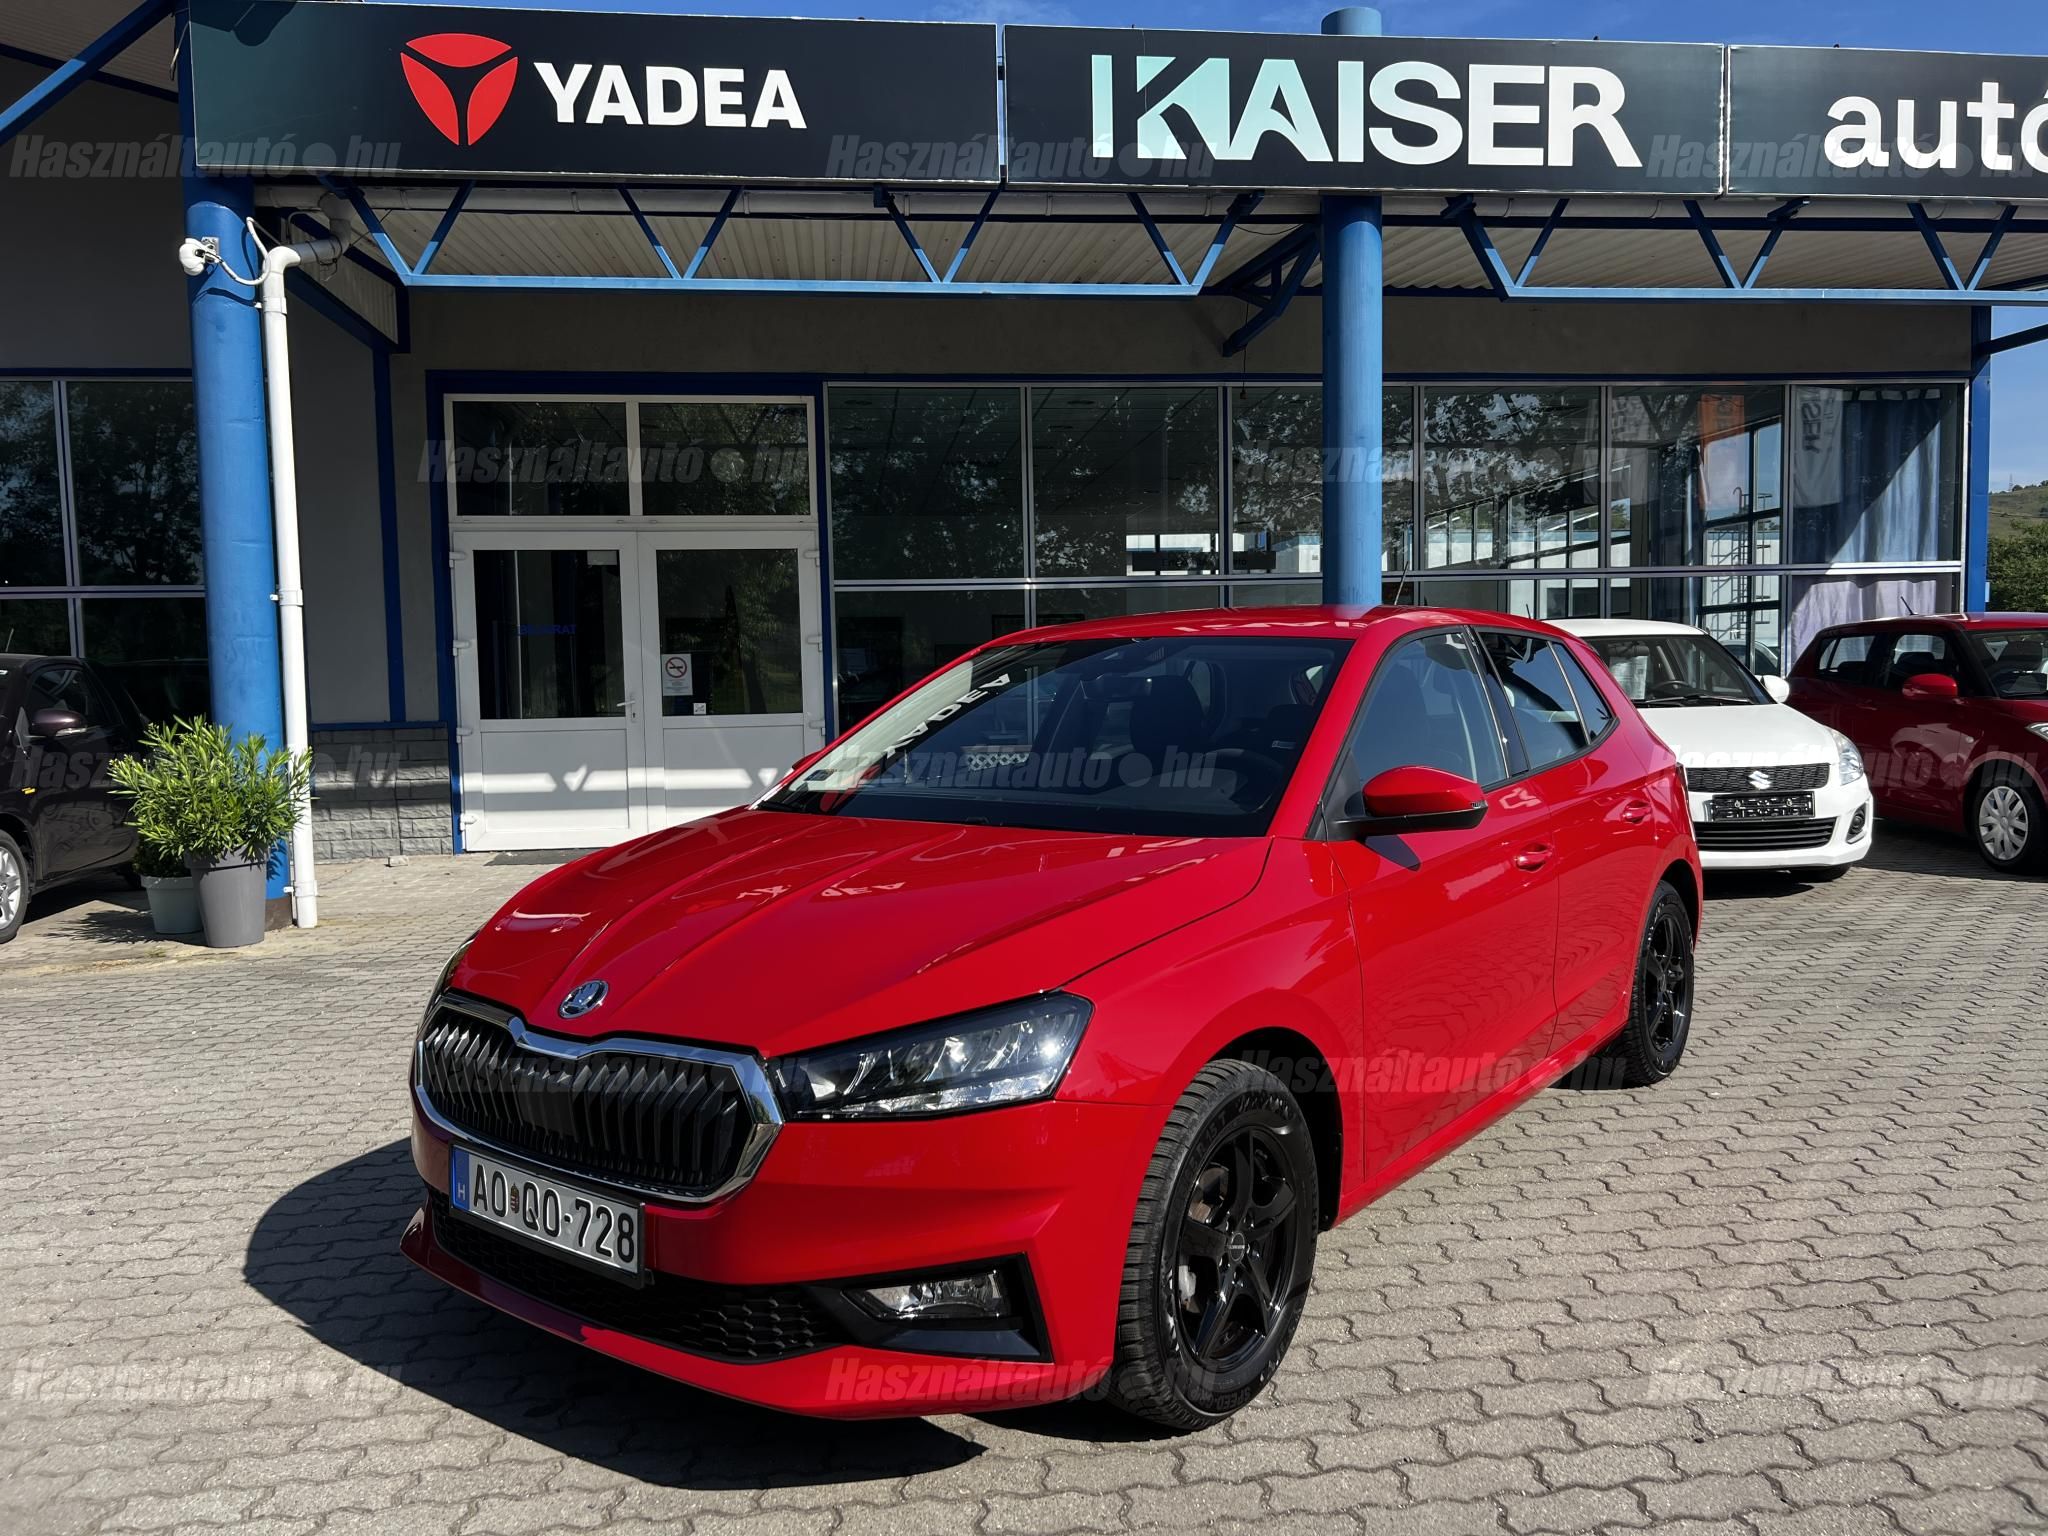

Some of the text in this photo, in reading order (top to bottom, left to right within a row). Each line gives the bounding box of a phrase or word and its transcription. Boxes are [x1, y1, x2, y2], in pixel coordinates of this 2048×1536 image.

[533, 62, 808, 130] YADEA
[1091, 53, 1644, 169] KAISER
[457, 1182, 466, 1202] H
[473, 1163, 636, 1264] AO QO-728
